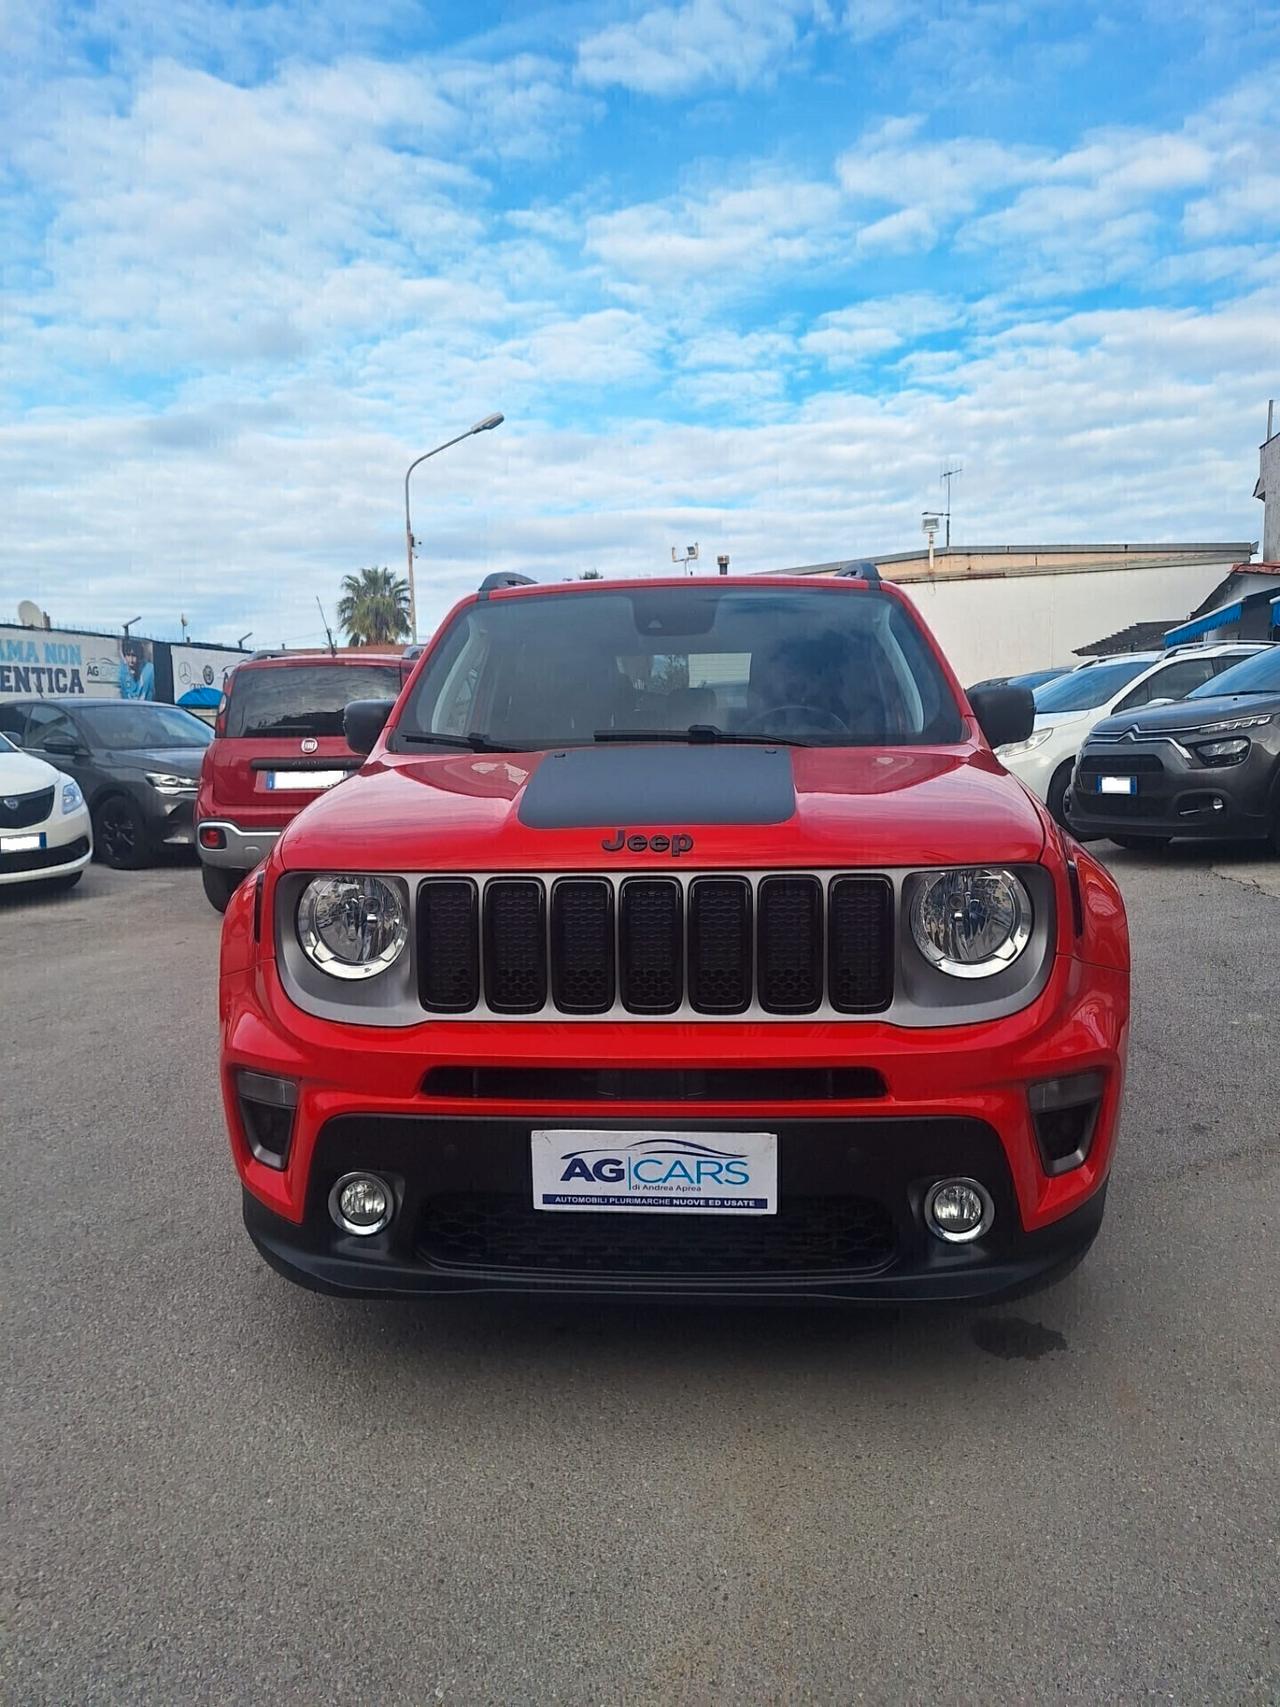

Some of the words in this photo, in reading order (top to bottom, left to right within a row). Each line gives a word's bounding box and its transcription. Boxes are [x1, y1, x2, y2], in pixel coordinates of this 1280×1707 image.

[45, 642, 81, 665] NON
[602, 830, 694, 857] Jeep
[560, 1158, 625, 1183] AG
[633, 1159, 750, 1185] CARS
[642, 1184, 674, 1192] Andrea
[555, 1196, 608, 1204] AUTOMOBILI
